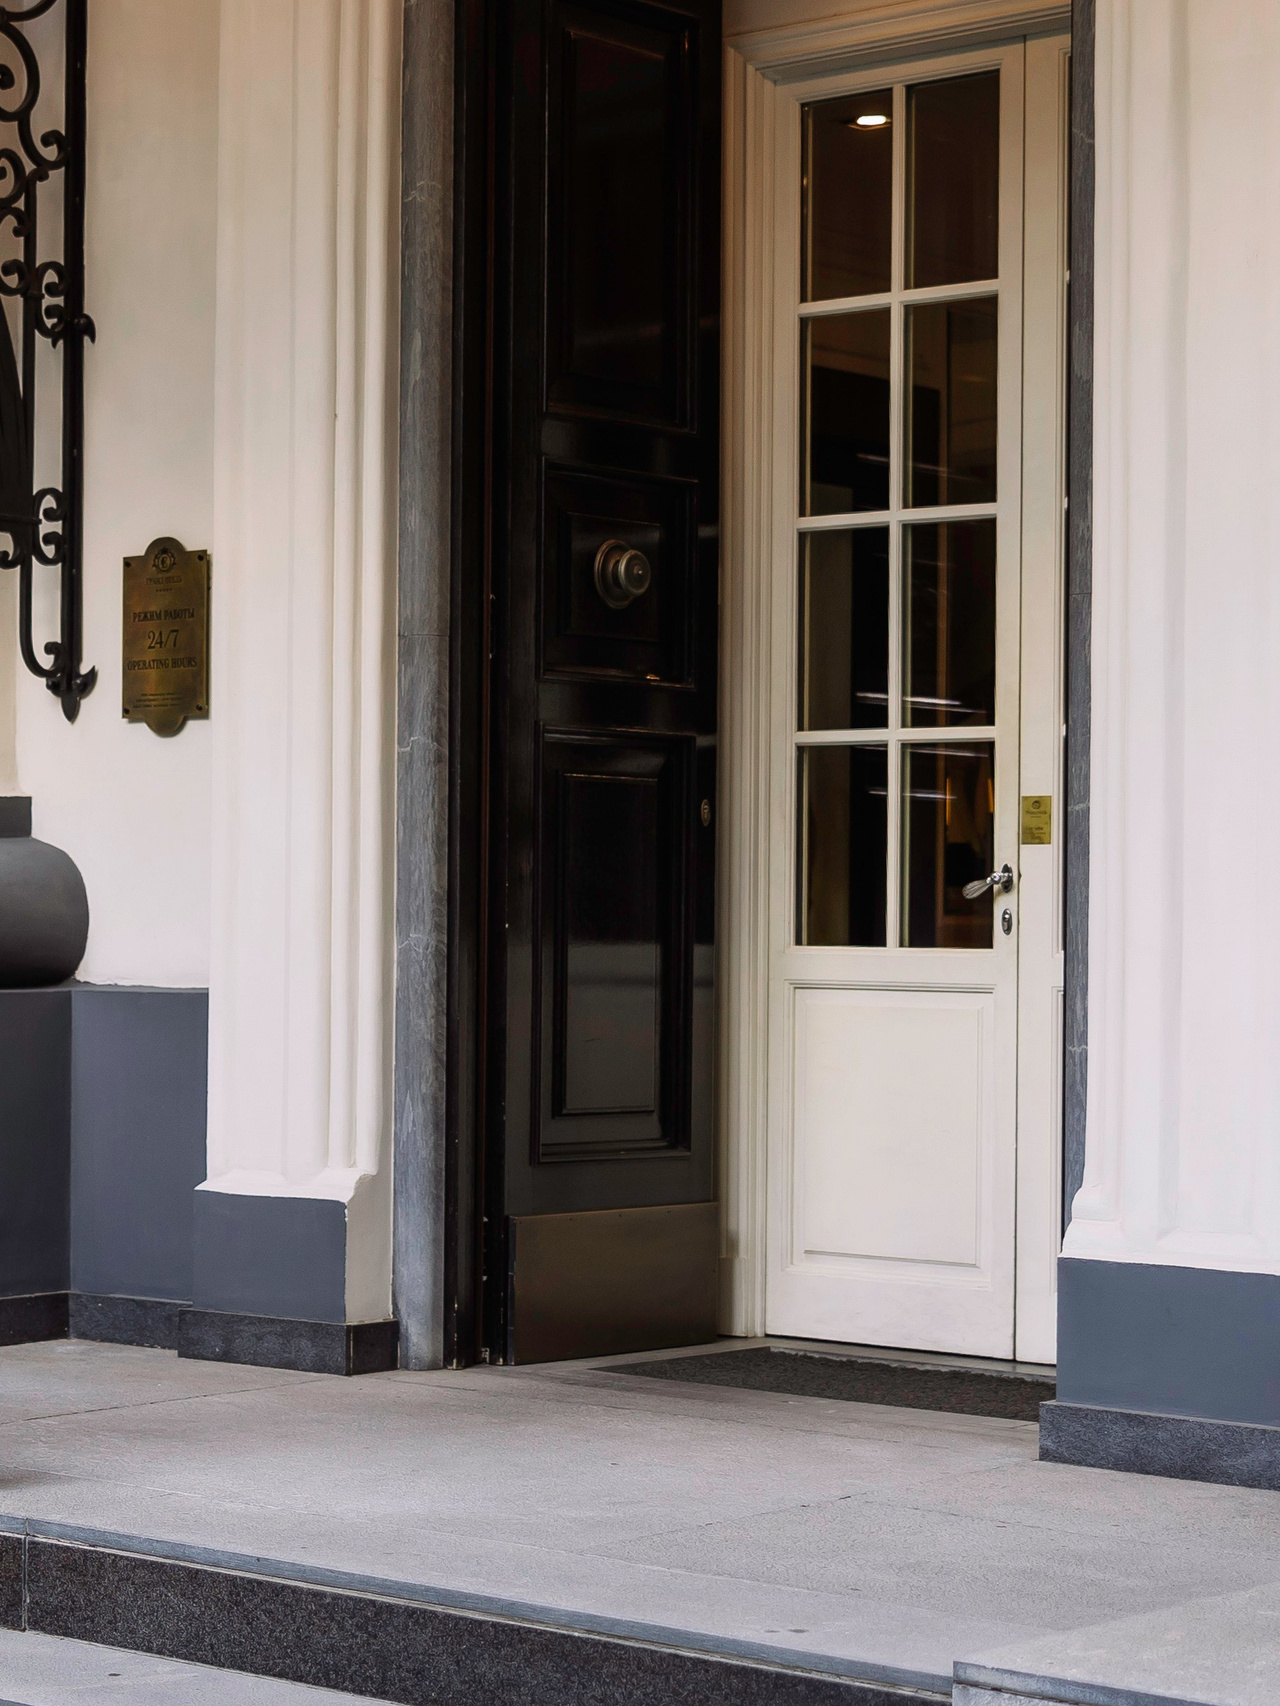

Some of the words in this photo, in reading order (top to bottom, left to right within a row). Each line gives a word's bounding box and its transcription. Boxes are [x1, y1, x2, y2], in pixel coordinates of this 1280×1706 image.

[132, 610, 162, 623] РЕЖИМ
[163, 608, 195, 620] РАБОТЫ
[147, 629, 180, 650] 24/7
[127, 658, 170, 671] OPERATING
[171, 656, 198, 669] HOURS
